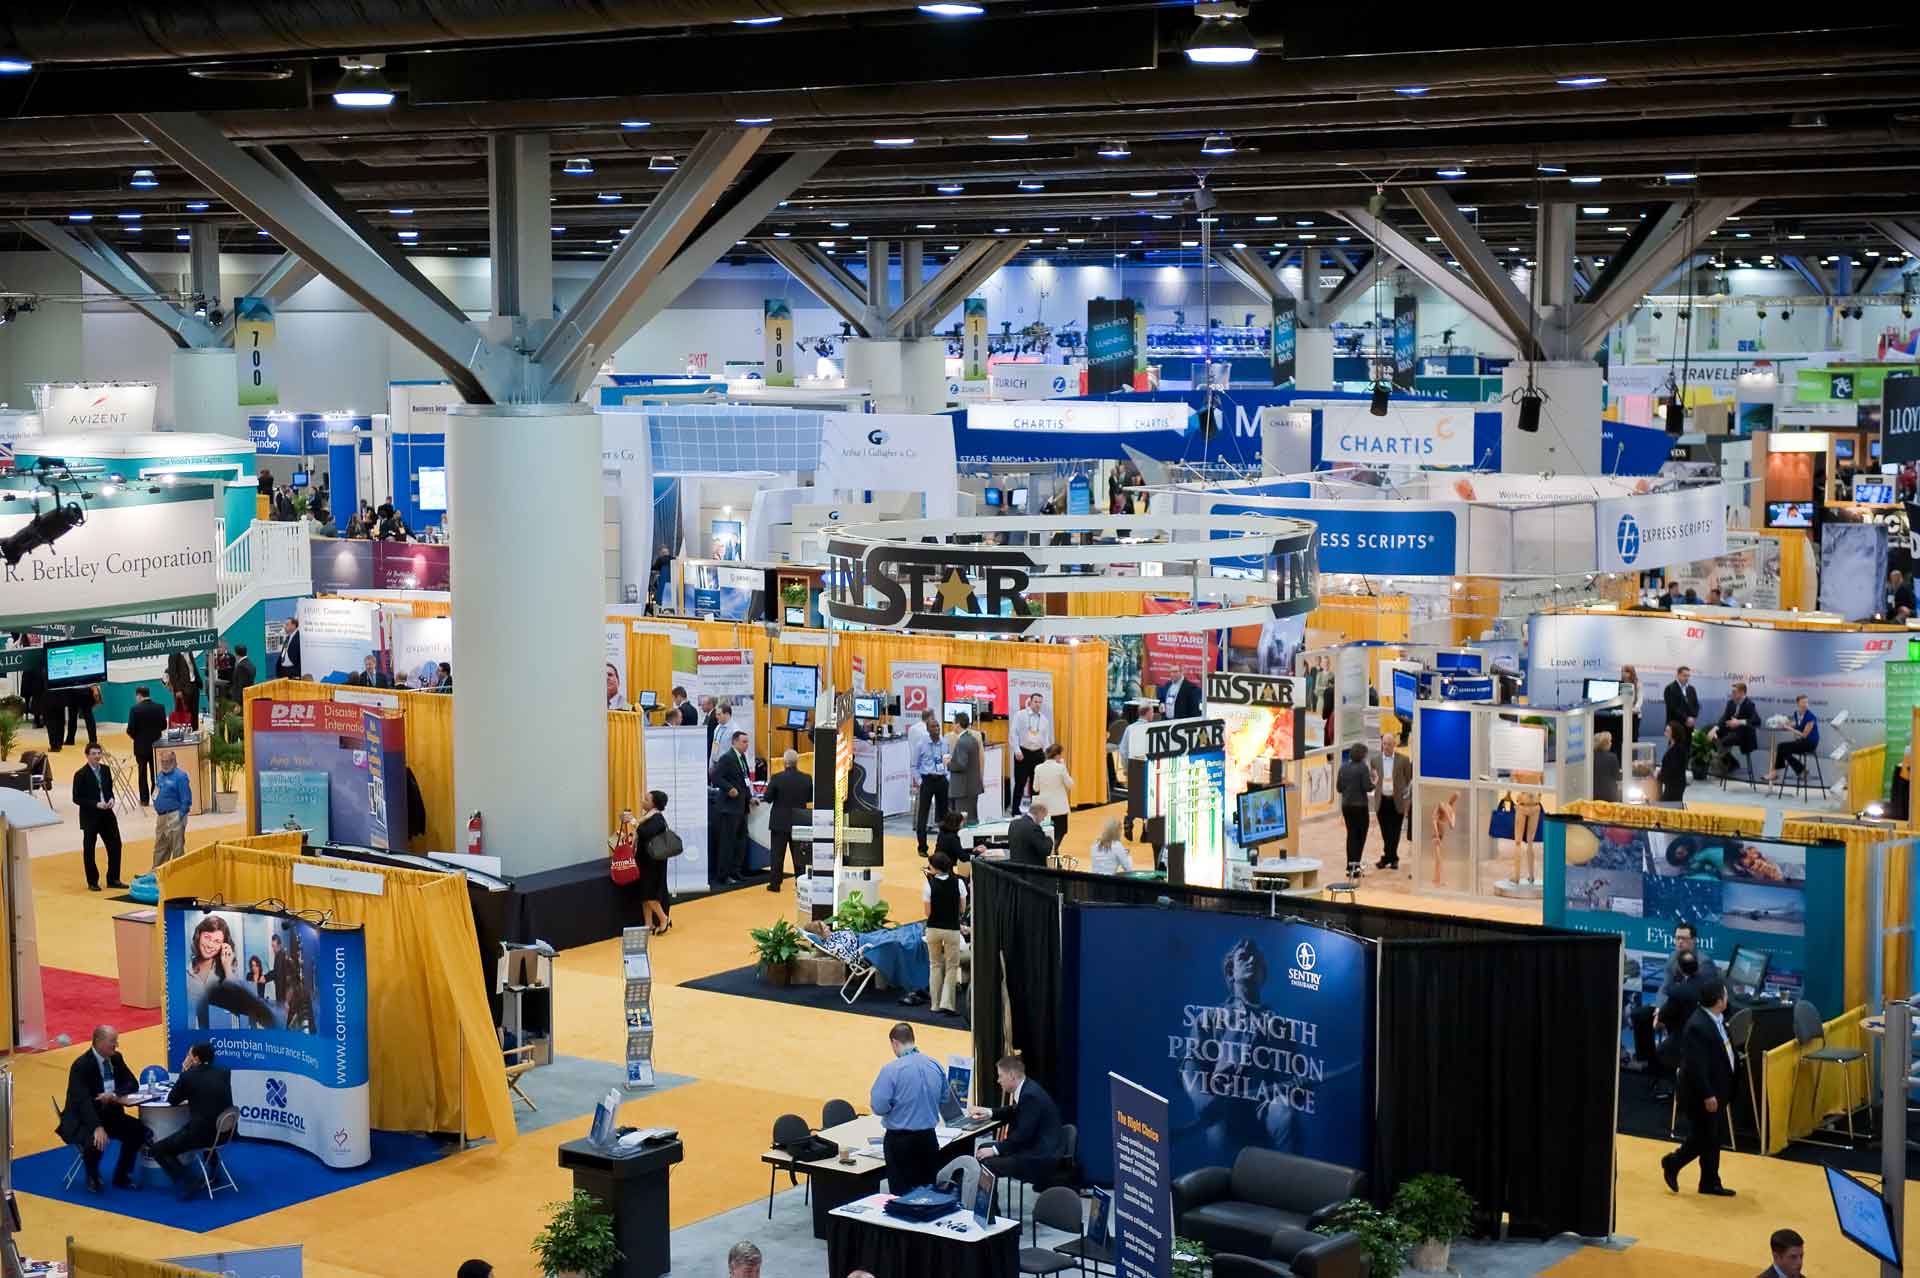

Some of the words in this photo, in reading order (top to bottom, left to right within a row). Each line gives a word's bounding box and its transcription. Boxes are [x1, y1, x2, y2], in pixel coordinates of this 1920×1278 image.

[251, 330, 262, 387] 700
[775, 327, 784, 374] 900
[68, 412, 129, 425] AVIZENT
[1013, 418, 1065, 429] CHARTIS
[1339, 435, 1433, 455] CHARTIS
[32, 556, 101, 584] Berkley
[106, 546, 214, 578] Corporation
[111, 642, 140, 656] Monitor
[140, 639, 165, 653] Liability
[166, 636, 199, 650] Managers,
[199, 632, 215, 645] LLC
[1207, 672, 1294, 706] INSTAR
[271, 703, 315, 720] DRI
[1146, 718, 1226, 761] INSTAR
[1646, 926, 1715, 950] Expent
[1288, 968, 1322, 985] SENTRY
[335, 946, 346, 1084] www.correcol.com
[1182, 1003, 1319, 1048] STRENGTH
[210, 1037, 263, 1052] Colombian
[1167, 1035, 1325, 1083] PROTECTION
[1181, 1070, 1317, 1115] VIGILANCE
[240, 1104, 306, 1131] CORRECOL
